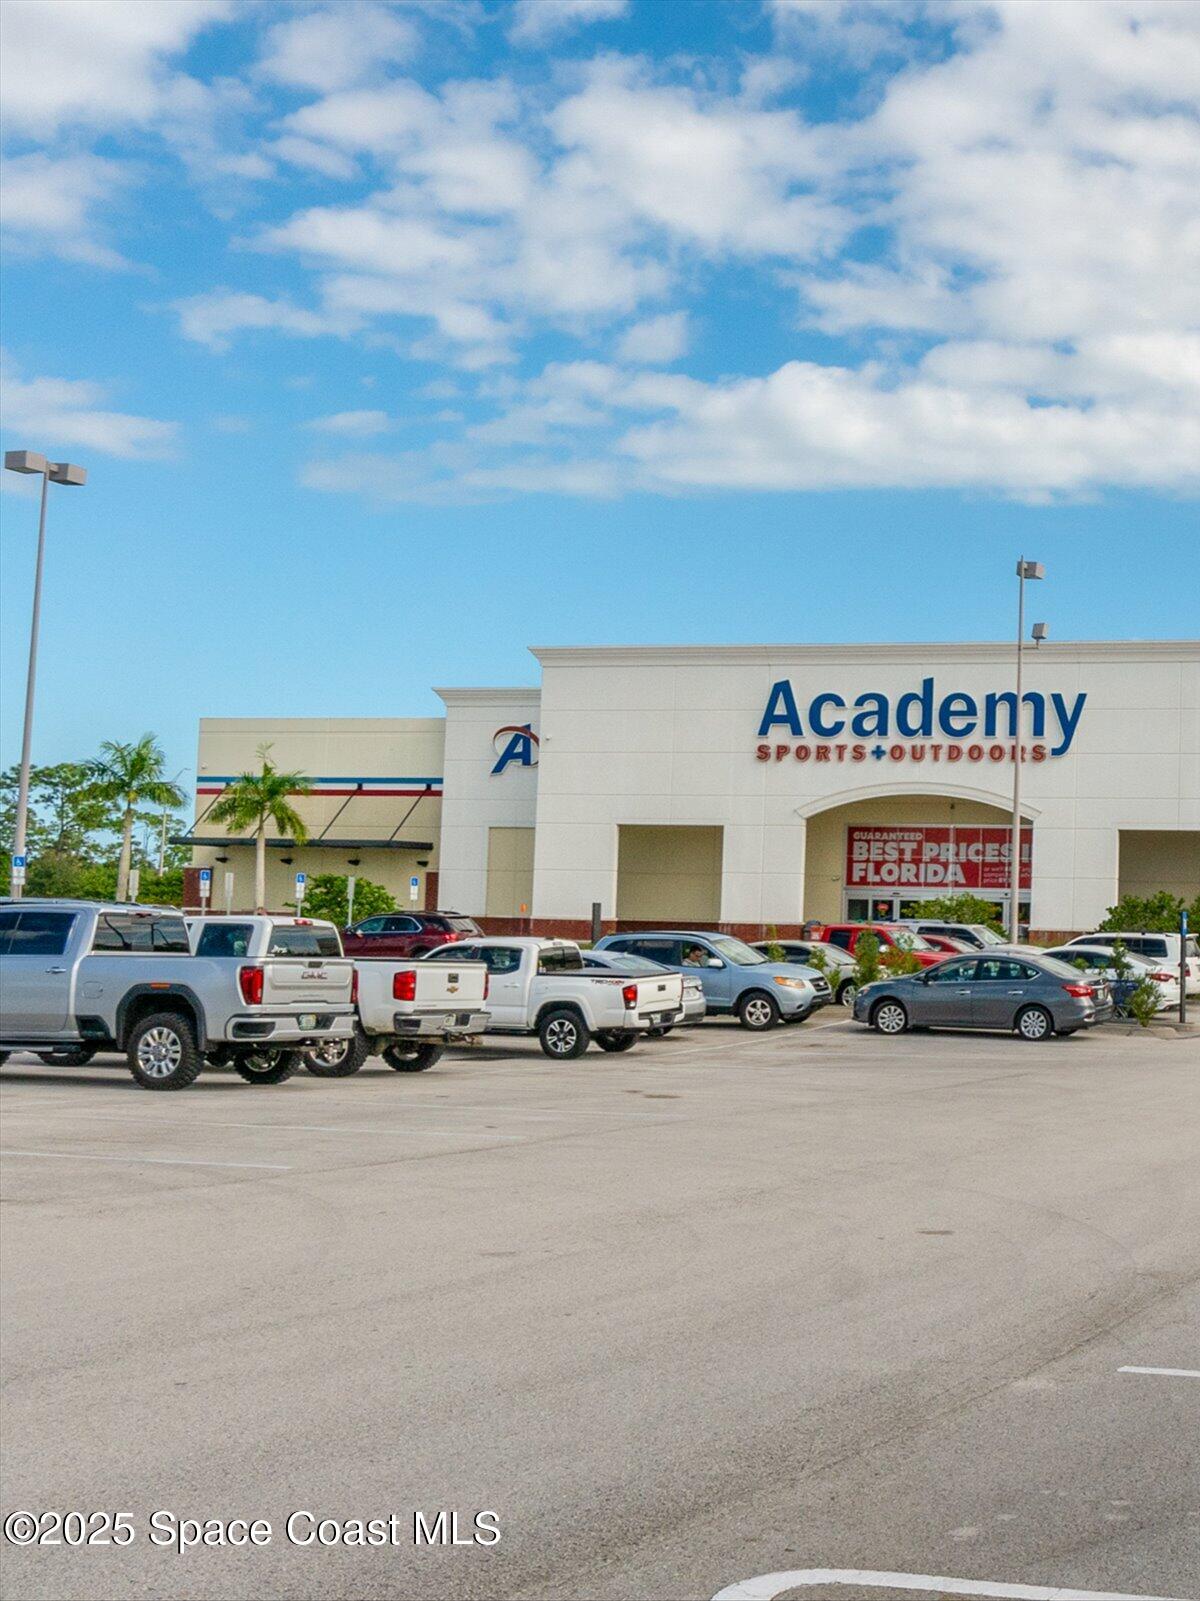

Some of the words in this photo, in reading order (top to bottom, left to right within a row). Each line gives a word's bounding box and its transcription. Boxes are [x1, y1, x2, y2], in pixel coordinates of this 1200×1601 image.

[757, 677, 1088, 756] Academy
[853, 832, 923, 841] GUARANTEED
[853, 841, 917, 862] BEST
[922, 842, 1013, 862] PRICES
[852, 863, 966, 883] FLORIDA
